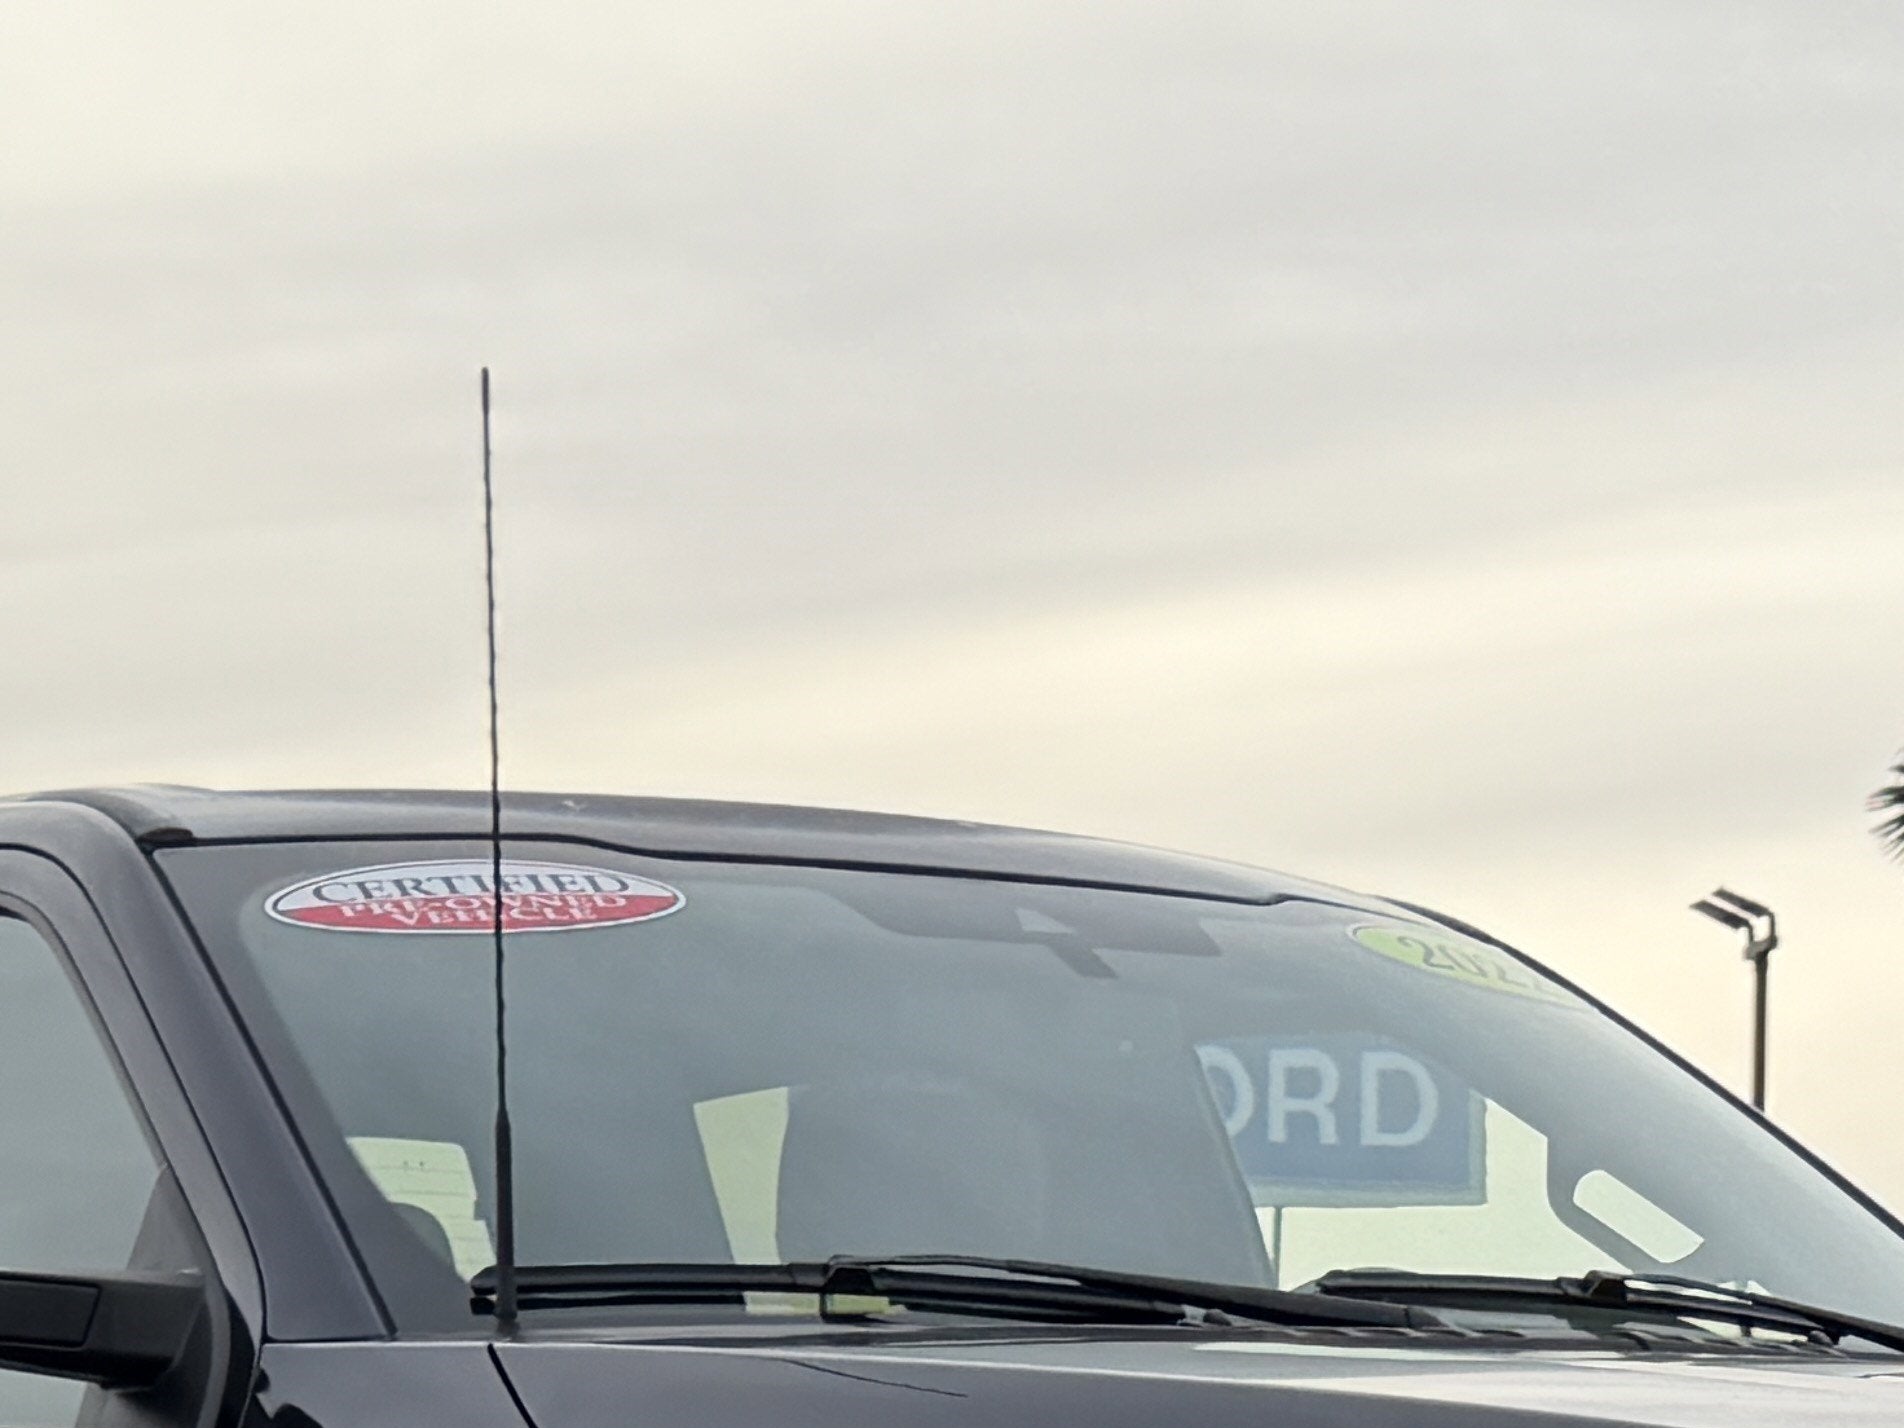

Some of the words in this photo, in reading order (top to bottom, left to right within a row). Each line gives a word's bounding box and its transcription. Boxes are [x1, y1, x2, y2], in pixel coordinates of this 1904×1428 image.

[312, 872, 631, 904] CERTIFIED
[391, 905, 598, 926] VEHCLE
[1195, 1044, 1440, 1148] ORD
